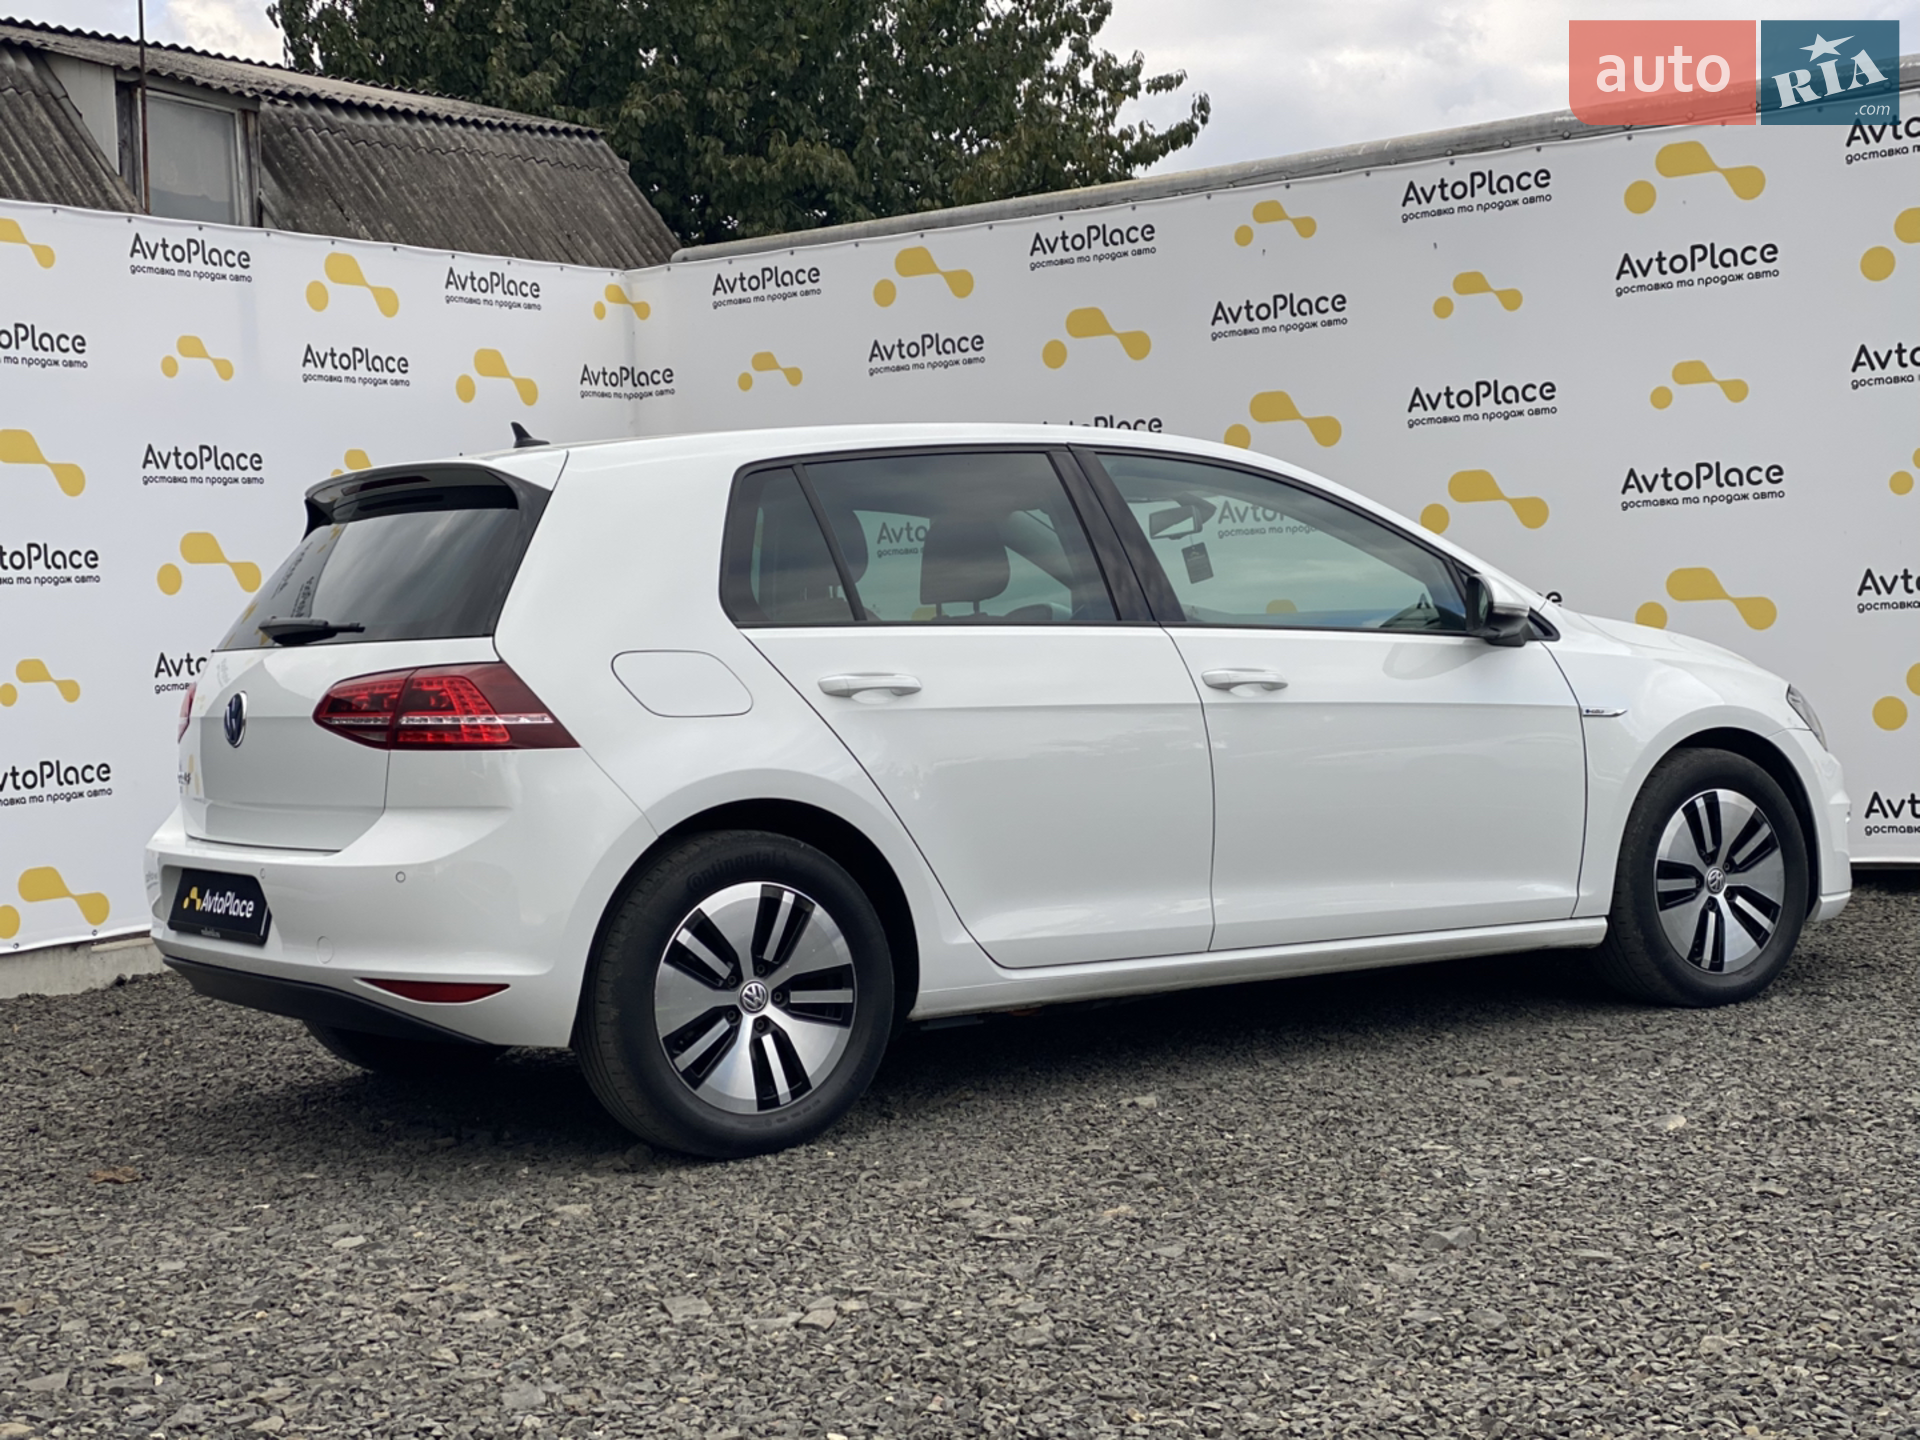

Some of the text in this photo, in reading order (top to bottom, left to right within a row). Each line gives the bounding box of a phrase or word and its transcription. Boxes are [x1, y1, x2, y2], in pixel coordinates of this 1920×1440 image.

[1845, 146, 1909, 165] доставка
[1402, 168, 1552, 207] AvtoPlace
[1401, 194, 1552, 223] доставка та продаж авто
[130, 233, 251, 269] AvtoPlace
[1030, 224, 1155, 256] AvtoPlace
[1030, 257, 1075, 271] доставка
[1093, 251, 1128, 262] продаж
[1131, 247, 1156, 256] авто
[1616, 242, 1778, 281] AvtoPlace
[130, 265, 252, 283] доставка та продаж авто
[445, 266, 540, 299] AvtoPlace
[712, 266, 820, 296] AvtoPlace
[1615, 269, 1779, 297] доставка та продаж авто
[712, 297, 751, 309] доставка
[767, 291, 797, 302] продаж
[800, 288, 821, 296] авто
[1211, 293, 1347, 326] AvtoPlace
[1211, 327, 1260, 341] доставка
[1279, 321, 1318, 333] продаж
[1320, 318, 1348, 327] авто
[302, 344, 409, 374] AvtoPlace
[869, 333, 984, 362] AvtoPlace
[21, 357, 60, 368] продаж
[62, 359, 88, 368] авто
[869, 364, 910, 376] доставка
[927, 360, 960, 370] продаж
[962, 356, 985, 365] авто
[302, 373, 410, 387] доставка та продаж авто
[580, 364, 674, 388] AvtoPlace
[1851, 374, 1914, 390] доставка
[1407, 379, 1556, 413] AvtoPlace
[1407, 407, 1557, 429] доставка та продаж авто
[142, 444, 263, 471] AvtoPlace
[142, 476, 188, 485] доставка
[190, 476, 203, 484] та
[205, 477, 239, 486] продаж
[1621, 461, 1784, 495] AvtoPlace
[1621, 490, 1785, 511] доставка та продаж авто
[1218, 527, 1266, 539] доставка
[34, 576, 72, 586] продаж
[74, 575, 100, 583] авто
[1857, 568, 1920, 596] Avt
[29, 795, 44, 803] та
[46, 791, 84, 803] продаж
[87, 788, 112, 798] авто
[200, 889, 254, 918] AvtoPlace
